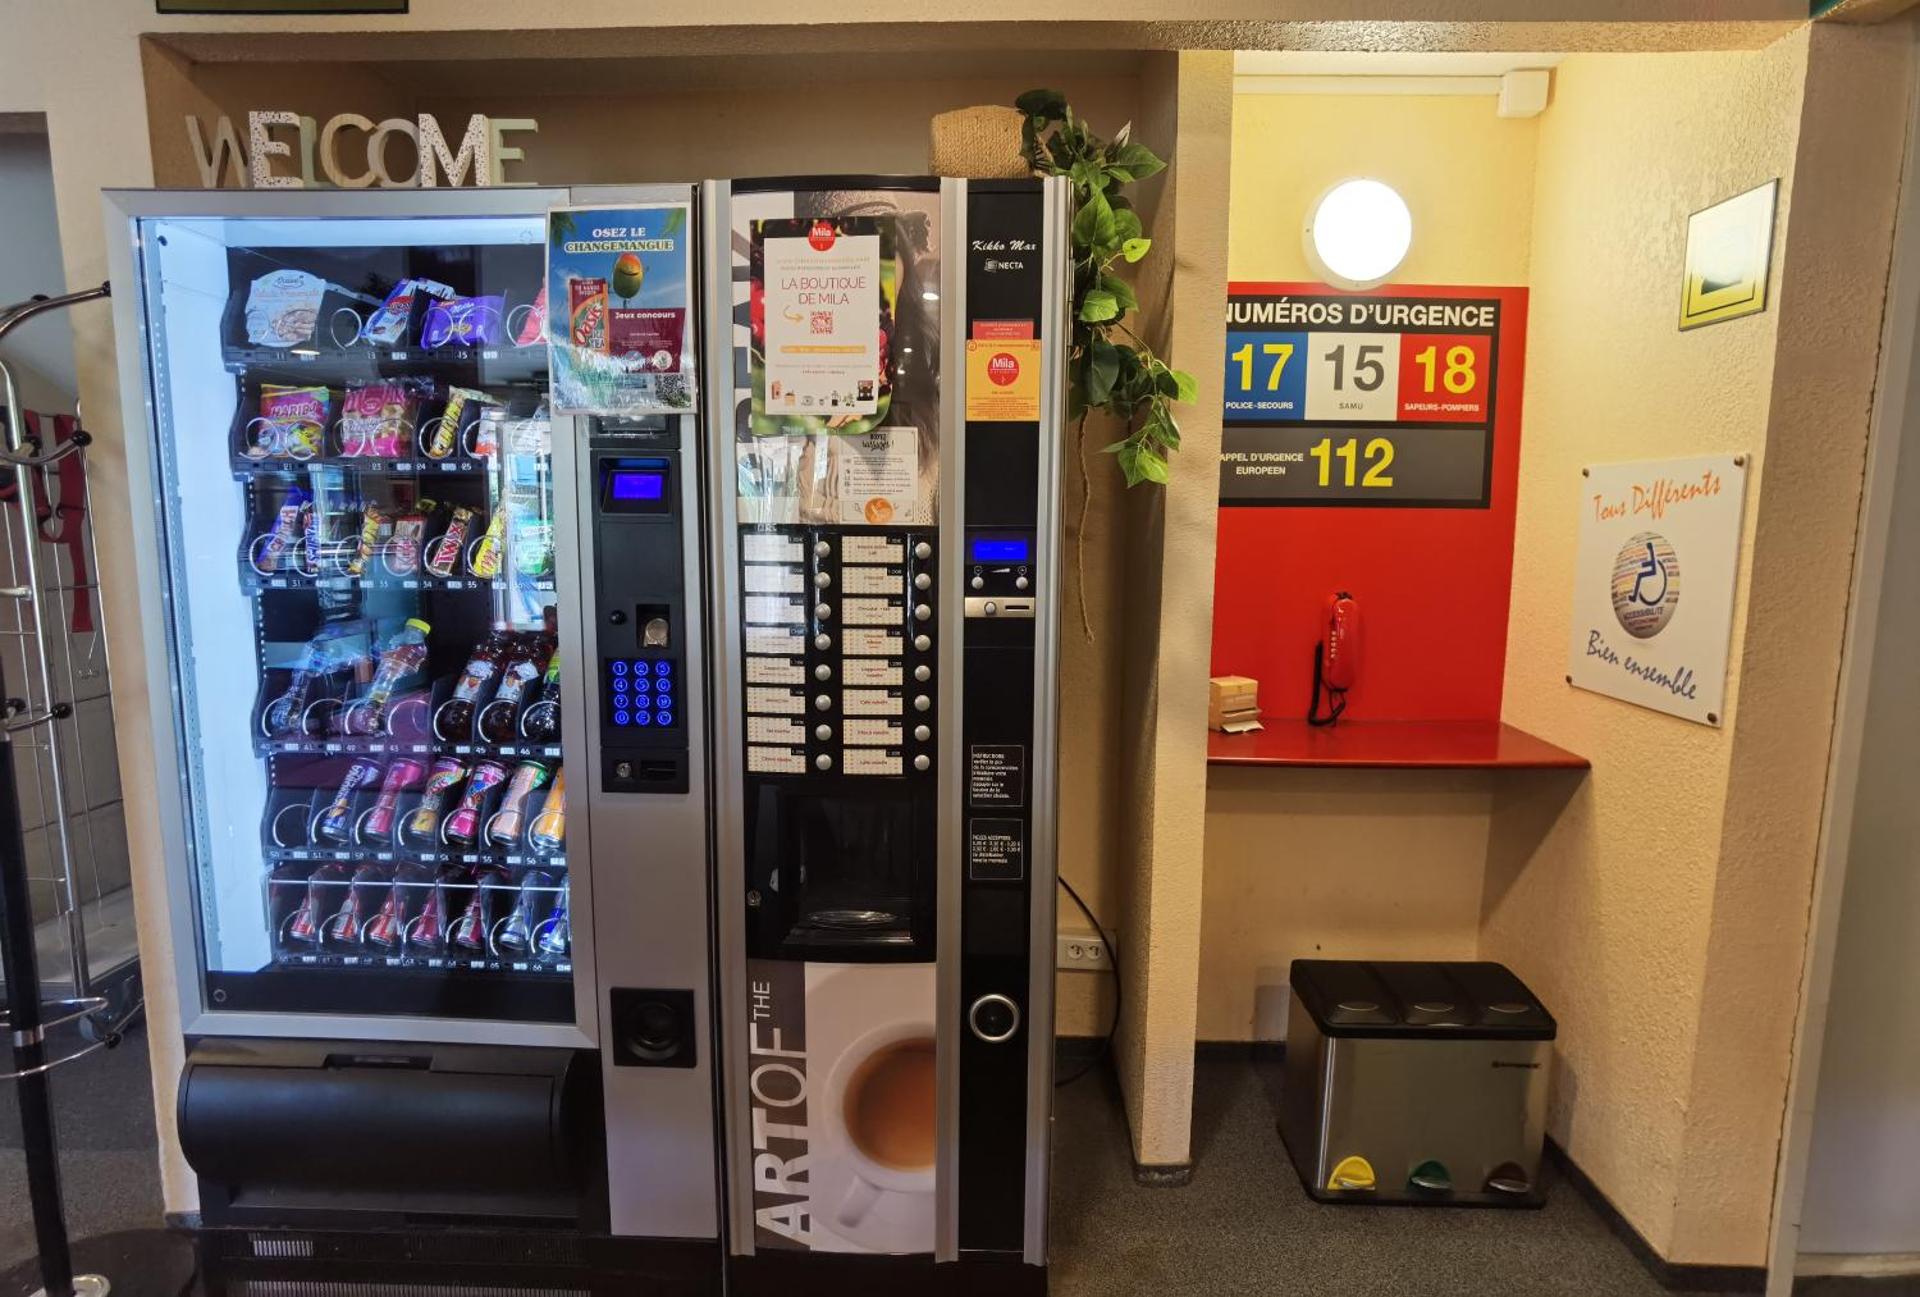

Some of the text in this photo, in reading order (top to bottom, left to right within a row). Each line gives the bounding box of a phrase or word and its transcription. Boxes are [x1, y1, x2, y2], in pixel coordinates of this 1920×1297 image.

[185, 111, 538, 188] WELCOME
[592, 227, 646, 238] OSEZ LE
[565, 240, 673, 253] CHANGEMANGUE
[972, 240, 1036, 251] Kikko Max
[998, 261, 1024, 270] NECTA
[781, 276, 866, 290] LA BOUTIQUE
[799, 292, 849, 305] DE MILA
[993, 358, 1015, 368] Mila
[1232, 343, 1294, 391] 17
[1324, 345, 1384, 391] 15
[1415, 345, 1476, 394] 18
[270, 401, 318, 418] HARIBO
[1225, 401, 1294, 410] POLICE-SECOURS
[1404, 403, 1480, 412] SAPEURS-POMPIERS
[1310, 438, 1394, 487] 112
[1236, 466, 1286, 475] EUROPEEN
[1594, 470, 1721, 522] Tous Différents
[1587, 630, 1697, 700] Bien ensemble
[750, 981, 813, 1251] ART OF THE
